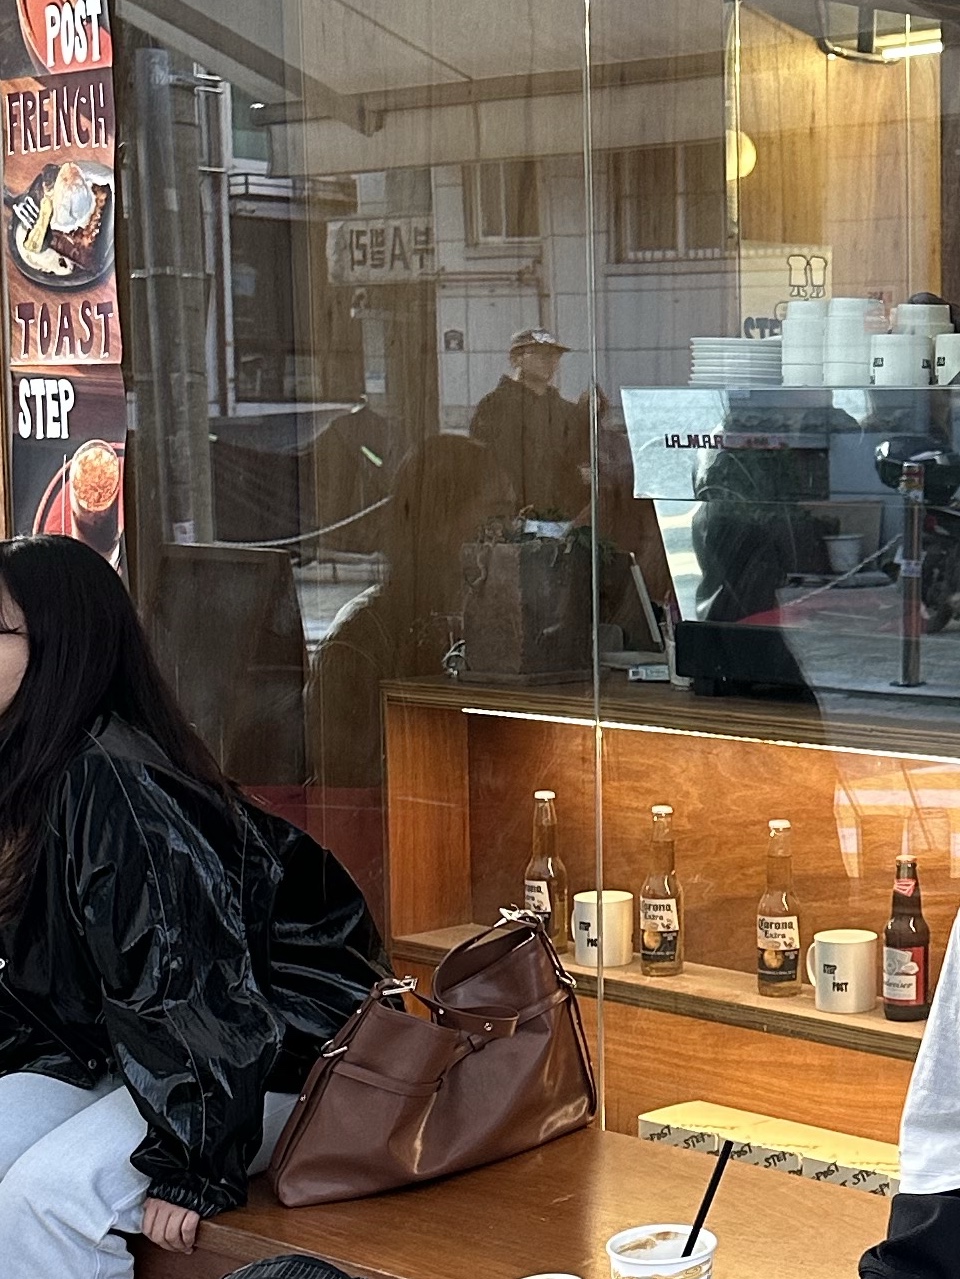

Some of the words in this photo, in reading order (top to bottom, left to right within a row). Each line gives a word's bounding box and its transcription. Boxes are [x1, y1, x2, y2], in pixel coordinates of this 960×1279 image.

[44, 0, 102, 67] POST
[6, 82, 109, 156] FRENCH
[14, 299, 114, 360] TOAST
[18, 378, 75, 440] STEP
[758, 918, 795, 931] Corona
